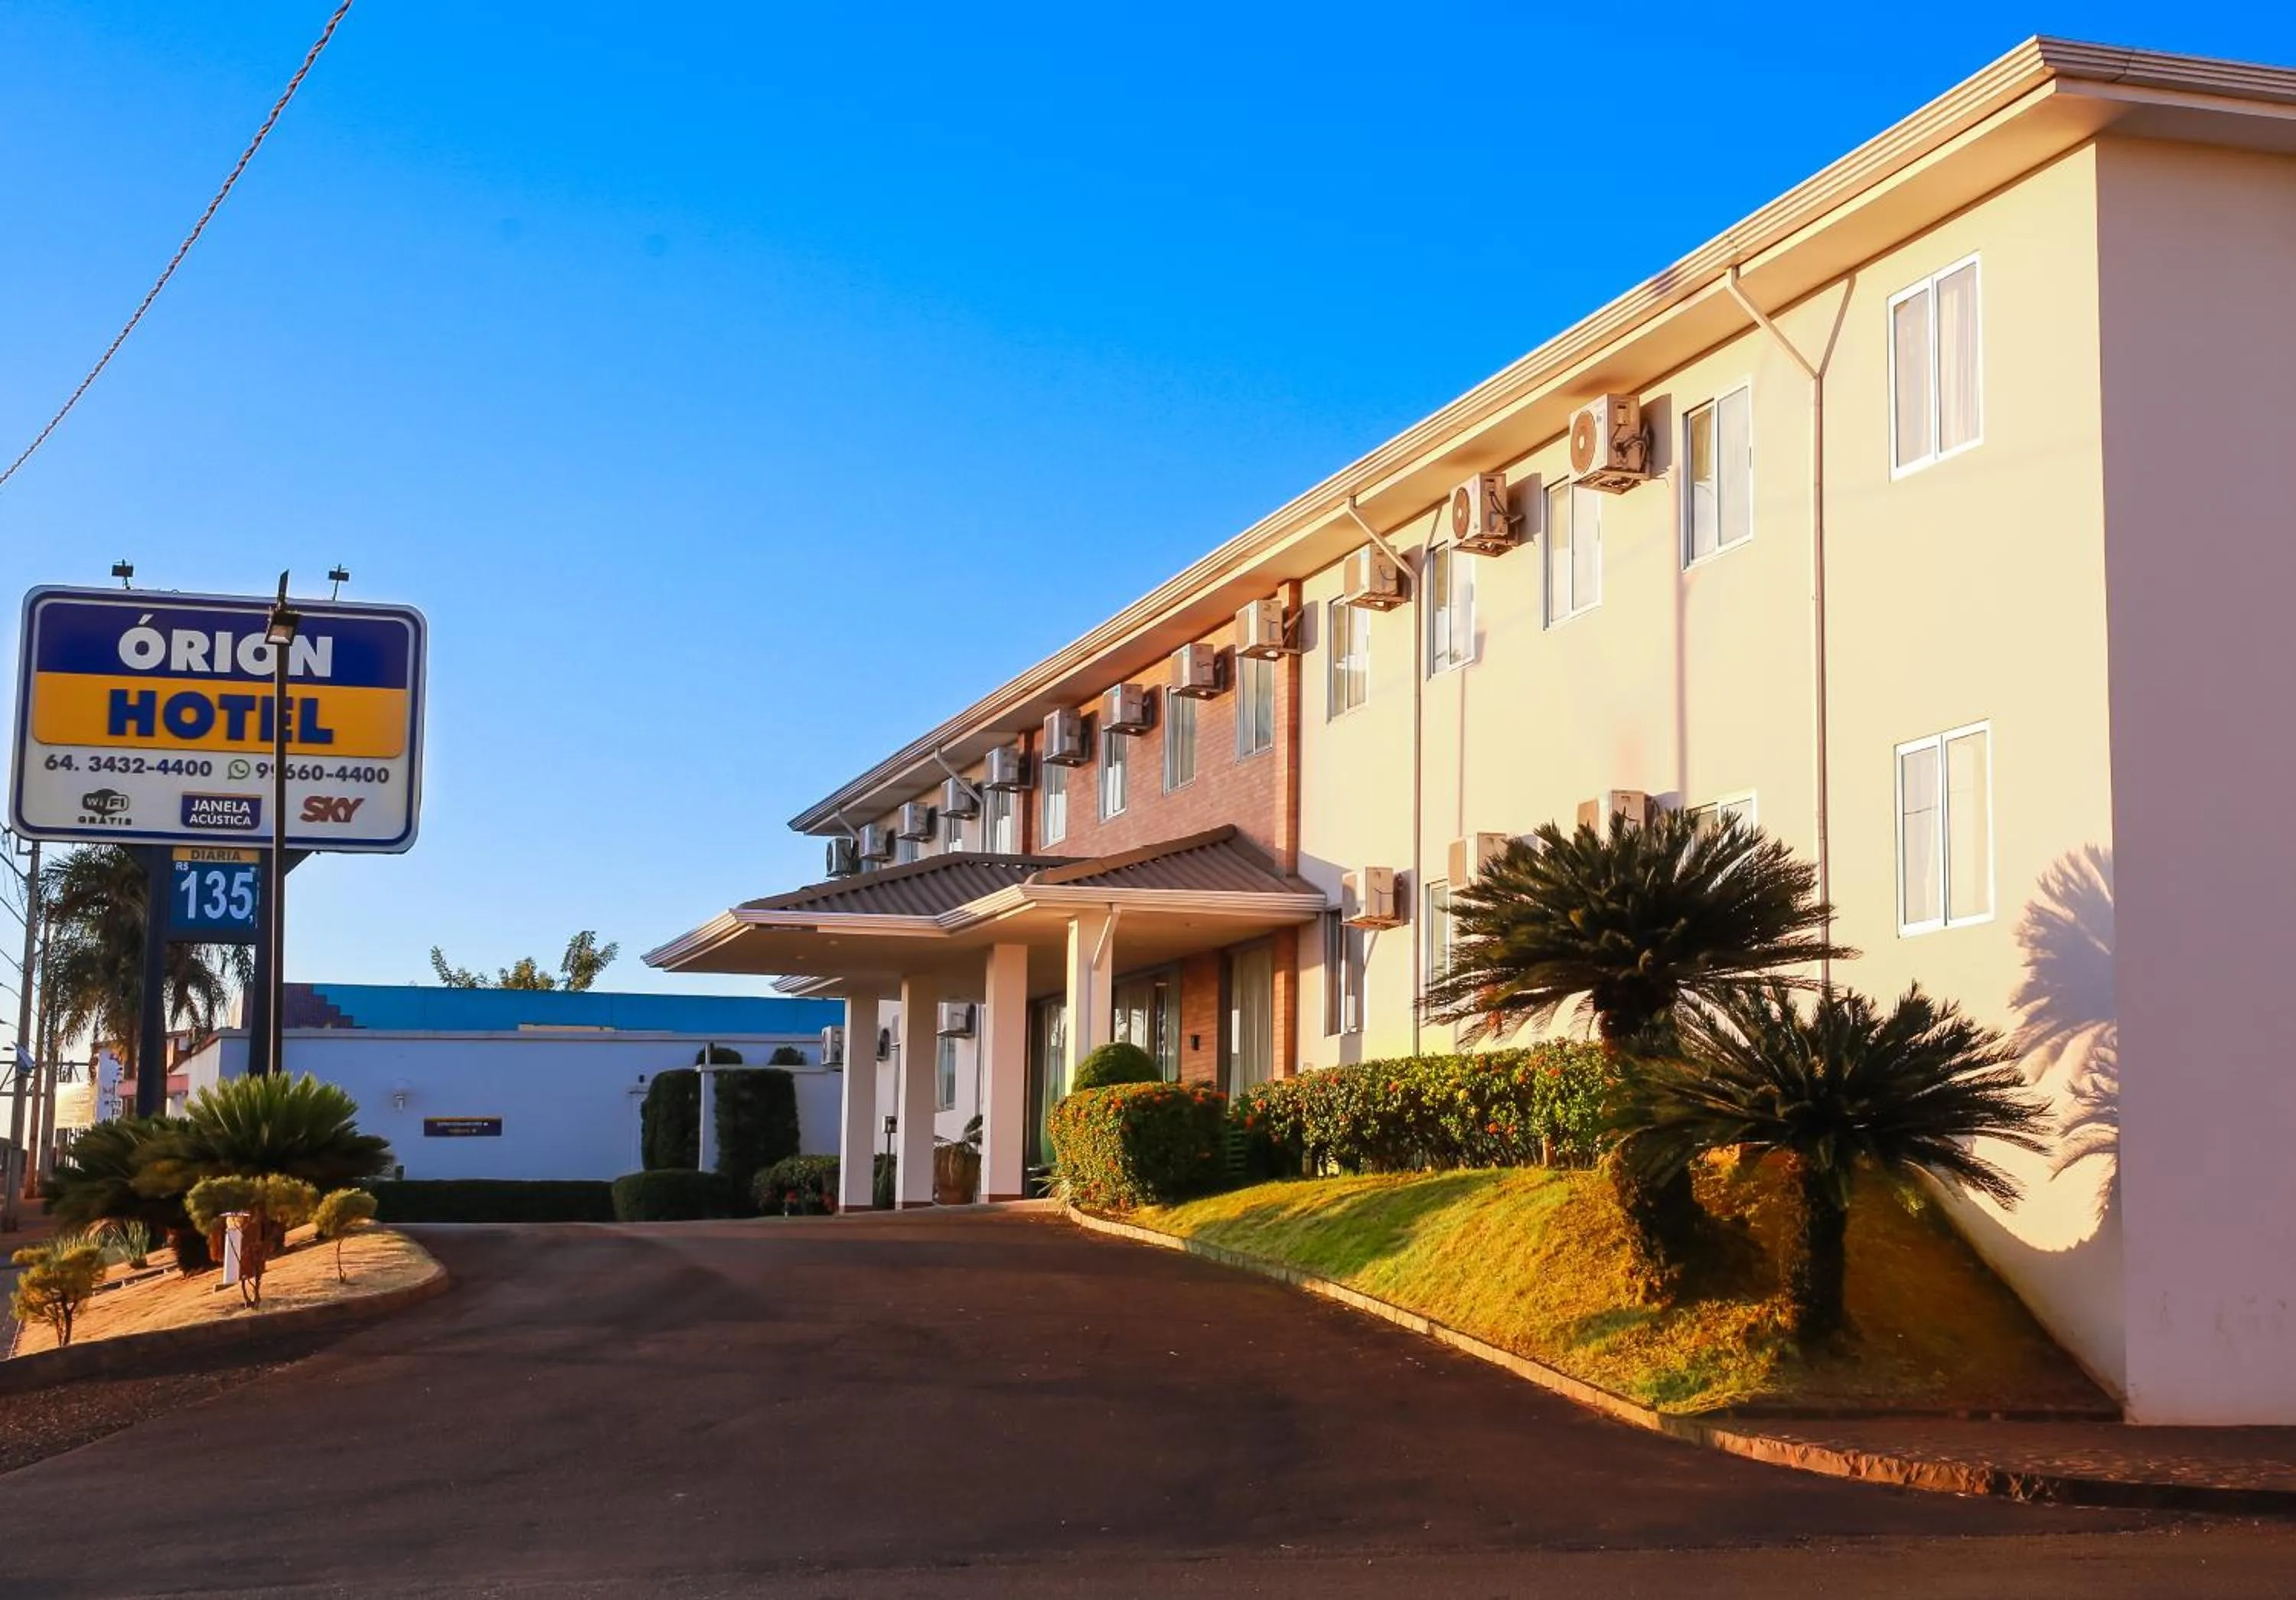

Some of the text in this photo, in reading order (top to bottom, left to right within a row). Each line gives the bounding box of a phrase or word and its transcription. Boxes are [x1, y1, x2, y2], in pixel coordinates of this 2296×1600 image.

[118, 613, 333, 678] ÓRION
[108, 689, 334, 744] HOTEL
[88, 756, 213, 776] 3432-4400
[256, 762, 390, 783] 9660-4400
[191, 800, 251, 813] JANELA
[300, 795, 365, 823] SKY
[189, 812, 253, 826] ACÚSTICA
[175, 861, 190, 871] R$
